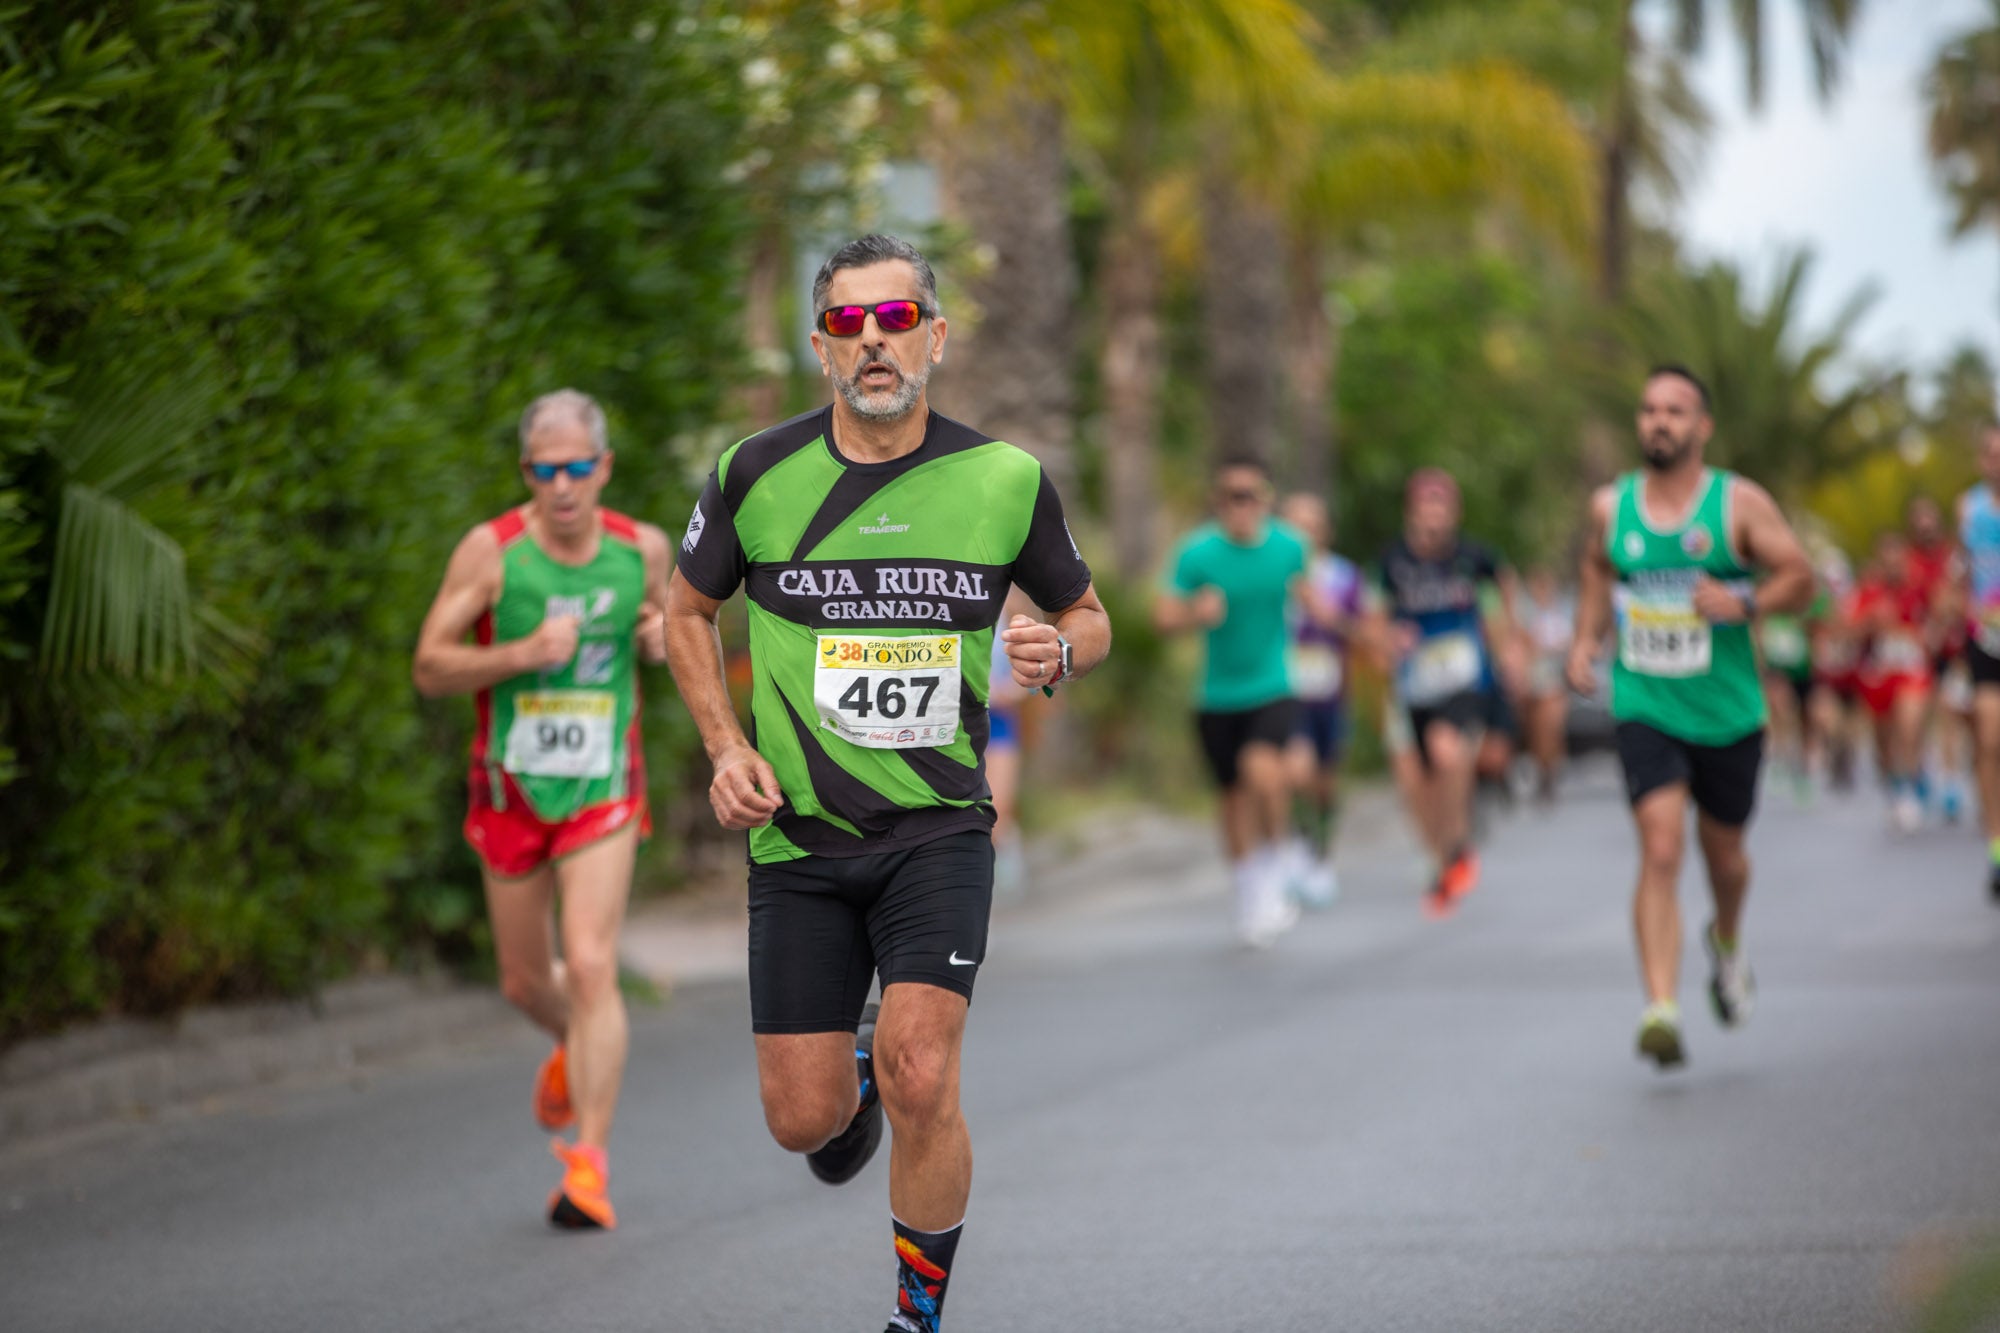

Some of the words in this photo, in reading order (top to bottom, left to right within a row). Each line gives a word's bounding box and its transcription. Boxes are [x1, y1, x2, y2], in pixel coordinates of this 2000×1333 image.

[858, 524, 911, 535] TEAMERGY
[777, 568, 863, 596] CAJA
[876, 567, 989, 600] RURAL
[821, 600, 952, 622] GRANADA
[839, 642, 863, 661] 38
[867, 641, 894, 650] GRAN
[896, 641, 927, 650] PREMIO
[863, 648, 932, 664] FONDO
[838, 676, 940, 719] 467
[535, 720, 585, 752] 90
